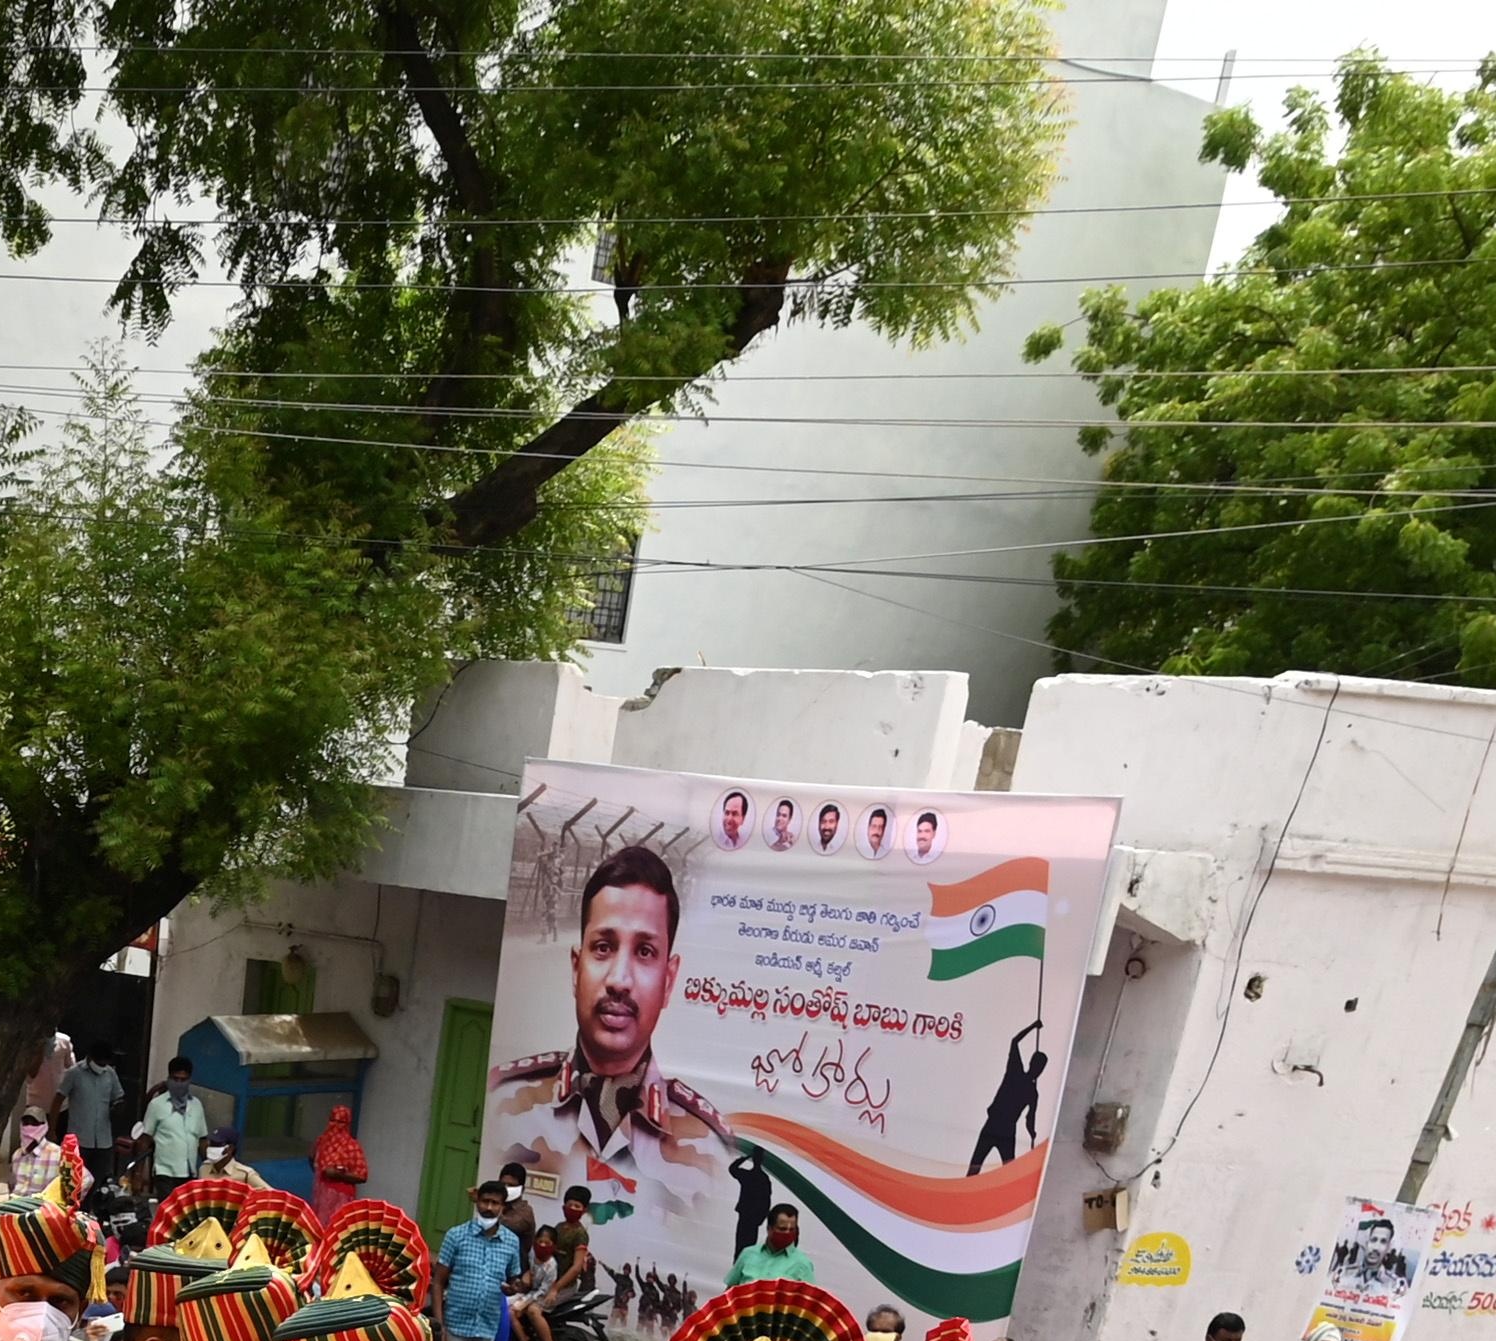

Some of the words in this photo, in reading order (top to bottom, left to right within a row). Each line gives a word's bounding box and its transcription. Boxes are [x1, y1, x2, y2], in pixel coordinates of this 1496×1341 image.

[820, 903, 853, 920] తెలుగు
[738, 922, 779, 940] తెలంగాణ
[683, 976, 770, 1020] బిక్కుమల్ల
[773, 985, 849, 1030] సంతోష్
[853, 1002, 909, 1032] బాబు
[912, 1011, 964, 1040] గారికి
